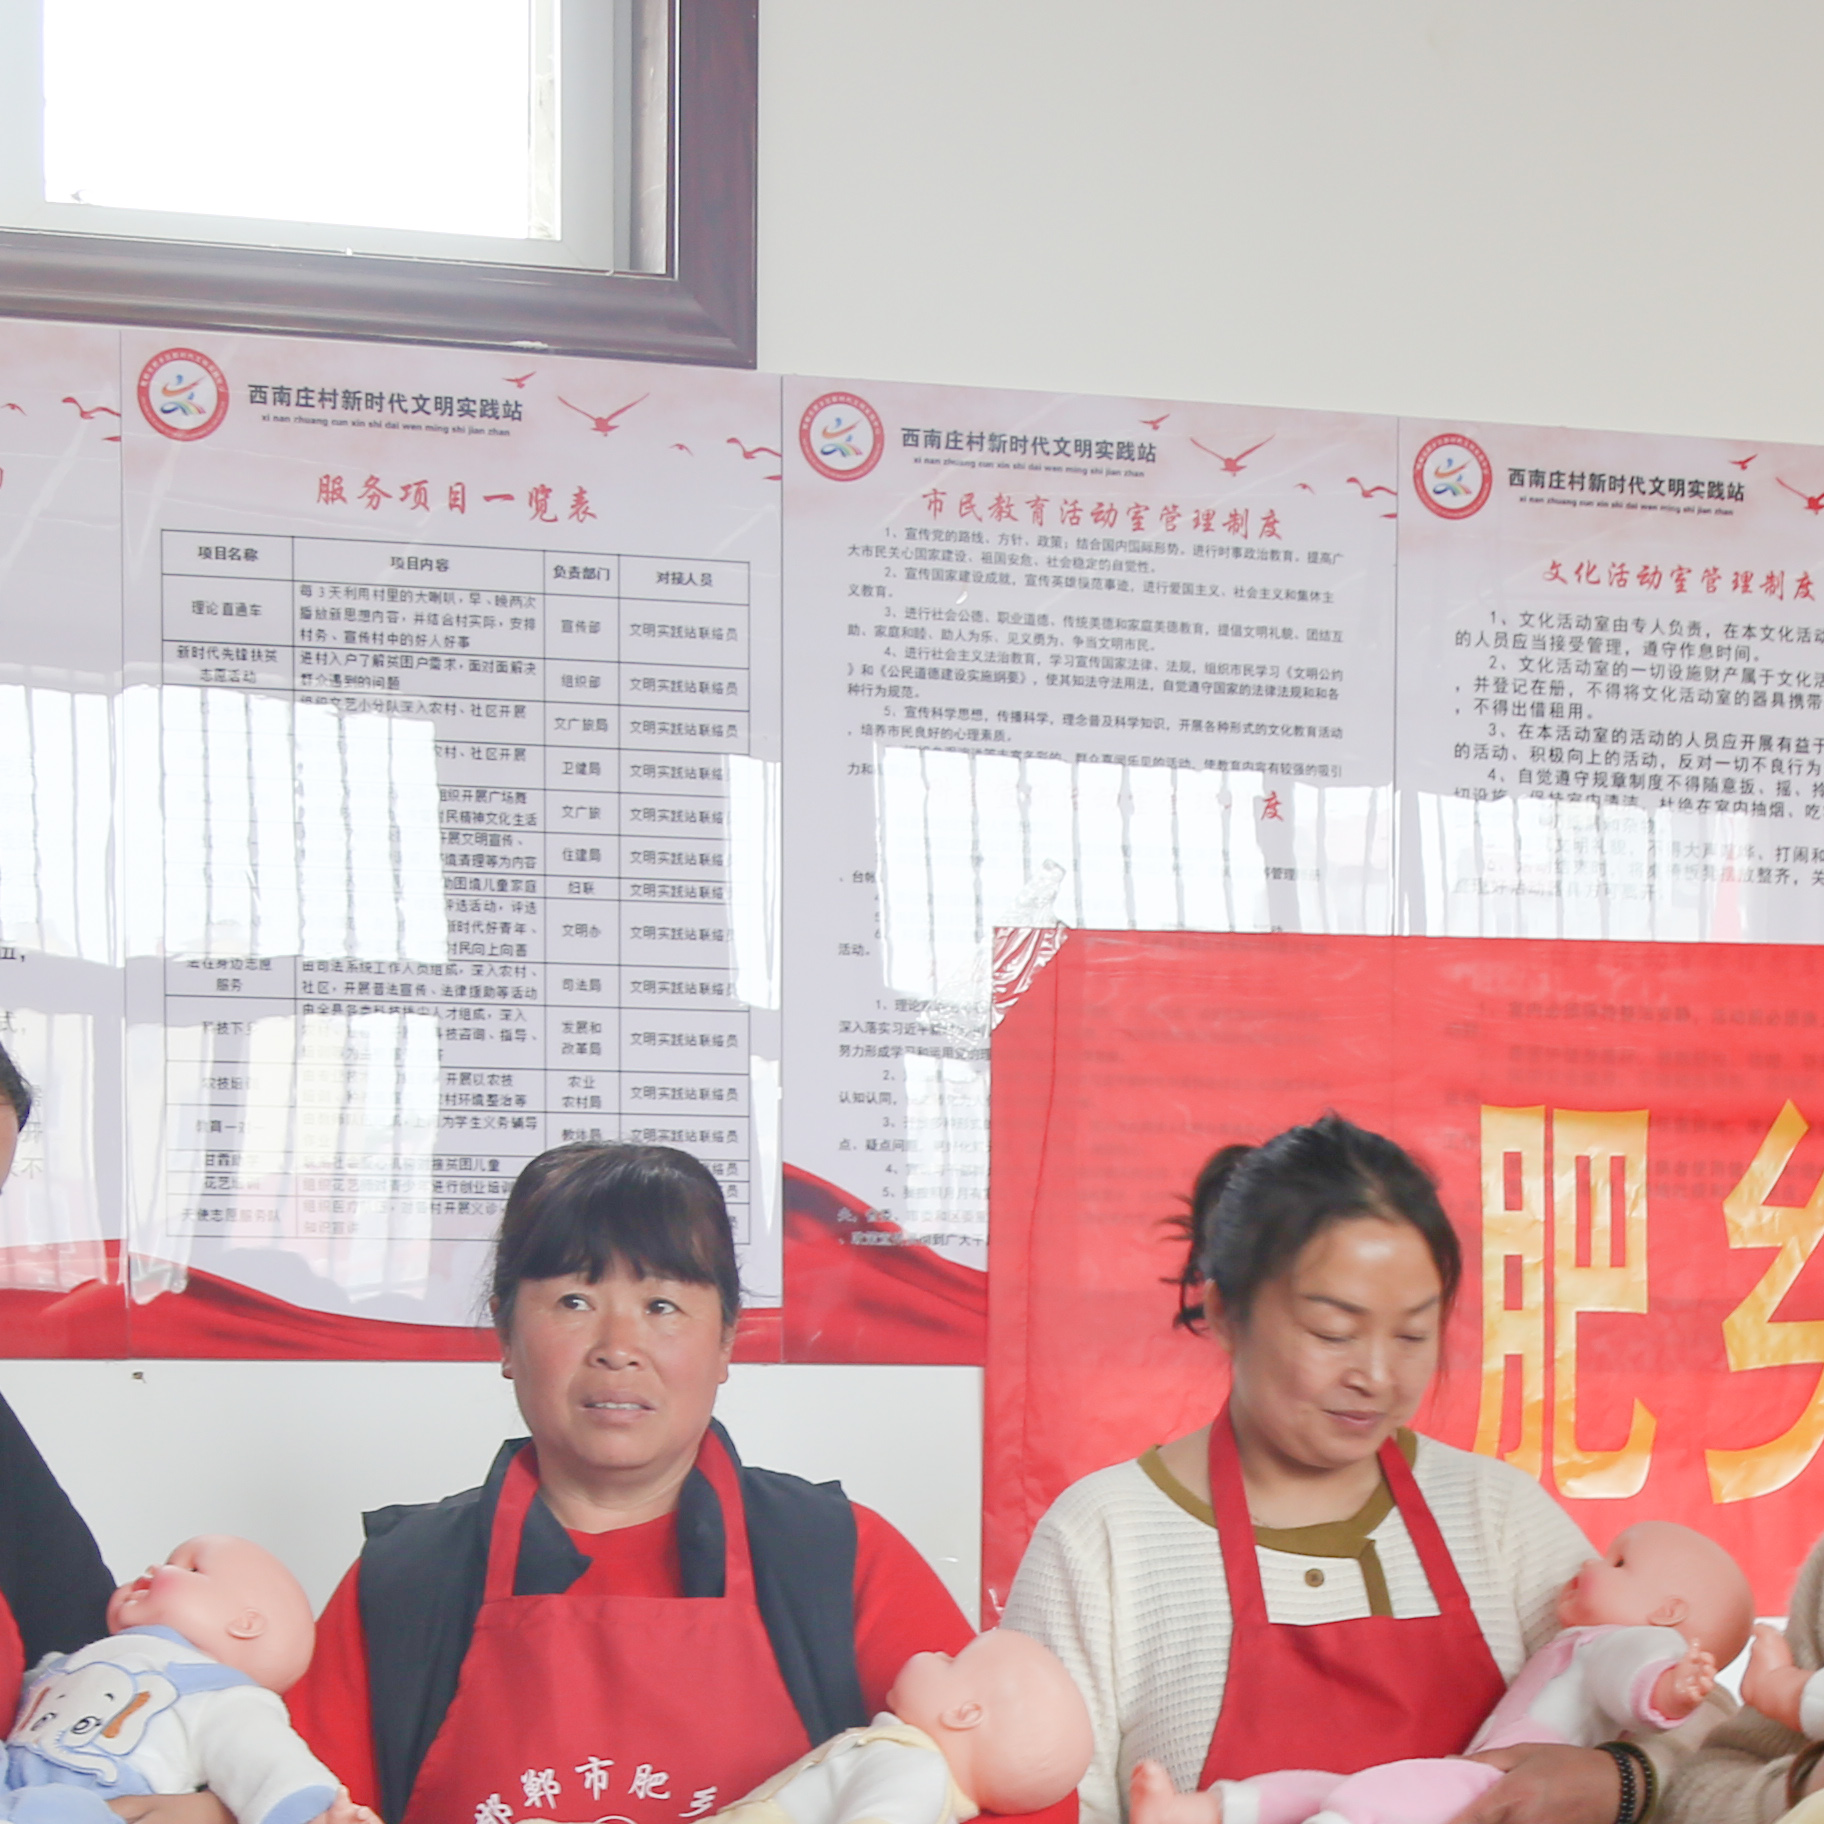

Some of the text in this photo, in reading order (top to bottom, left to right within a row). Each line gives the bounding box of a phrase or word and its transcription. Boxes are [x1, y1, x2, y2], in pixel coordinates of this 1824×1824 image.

[248, 384, 523, 422] 西南庄村新时代文明实践站
[261, 413, 511, 437] xi nan zhuang cun xin shi dai wen ming shi jian zhan
[901, 428, 1157, 463] 西南庄村新时代文明实践站
[1508, 467, 1746, 502] 西南庄村新时代文明实践站
[317, 473, 598, 524] 服务项目一览表
[921, 487, 1284, 541] 市民教育活动室管理制度
[198, 545, 259, 562] 项目名称
[390, 556, 449, 573] 项目内容
[553, 564, 611, 582] 负责部门
[655, 570, 714, 588] 对接人员
[1543, 559, 1818, 602] 文化活动室管理制度
[191, 600, 262, 618] 理论直通车
[561, 618, 601, 635] 宣传部
[199, 667, 257, 684] 志愿活动
[561, 673, 601, 690] 组织部
[629, 764, 732, 782] 文明实践站联络
[629, 808, 732, 825] 文明实践站联络
[629, 850, 732, 868] 文明实践站联络
[629, 883, 732, 900] 文明实践站联络
[215, 978, 243, 993] 服务
